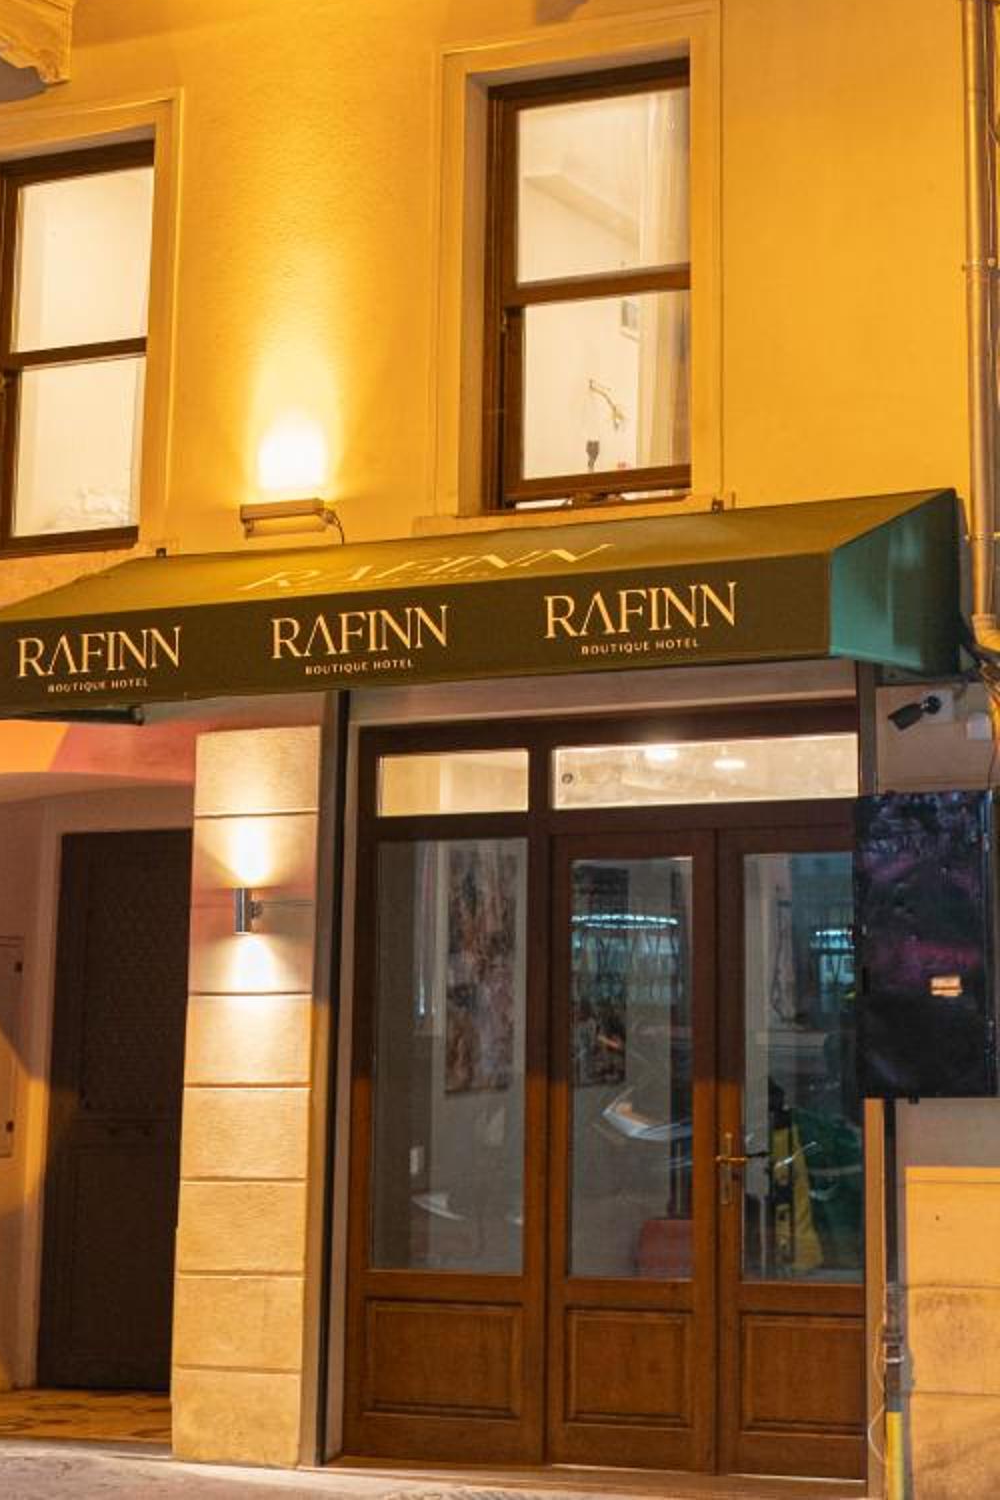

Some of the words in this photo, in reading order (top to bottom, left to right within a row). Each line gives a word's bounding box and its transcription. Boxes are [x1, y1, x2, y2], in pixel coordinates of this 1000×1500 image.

[543, 581, 738, 639] RAFINN
[271, 605, 449, 660] RAFINN
[581, 640, 649, 655] BOUTIQUE
[655, 637, 699, 650] HOTEL
[17, 626, 182, 678] RAFINN
[305, 660, 369, 675] BOUTIQUE
[373, 658, 412, 670] HOTEL
[47, 681, 106, 693] BOUTIQUE
[111, 677, 148, 690] HOTEL
